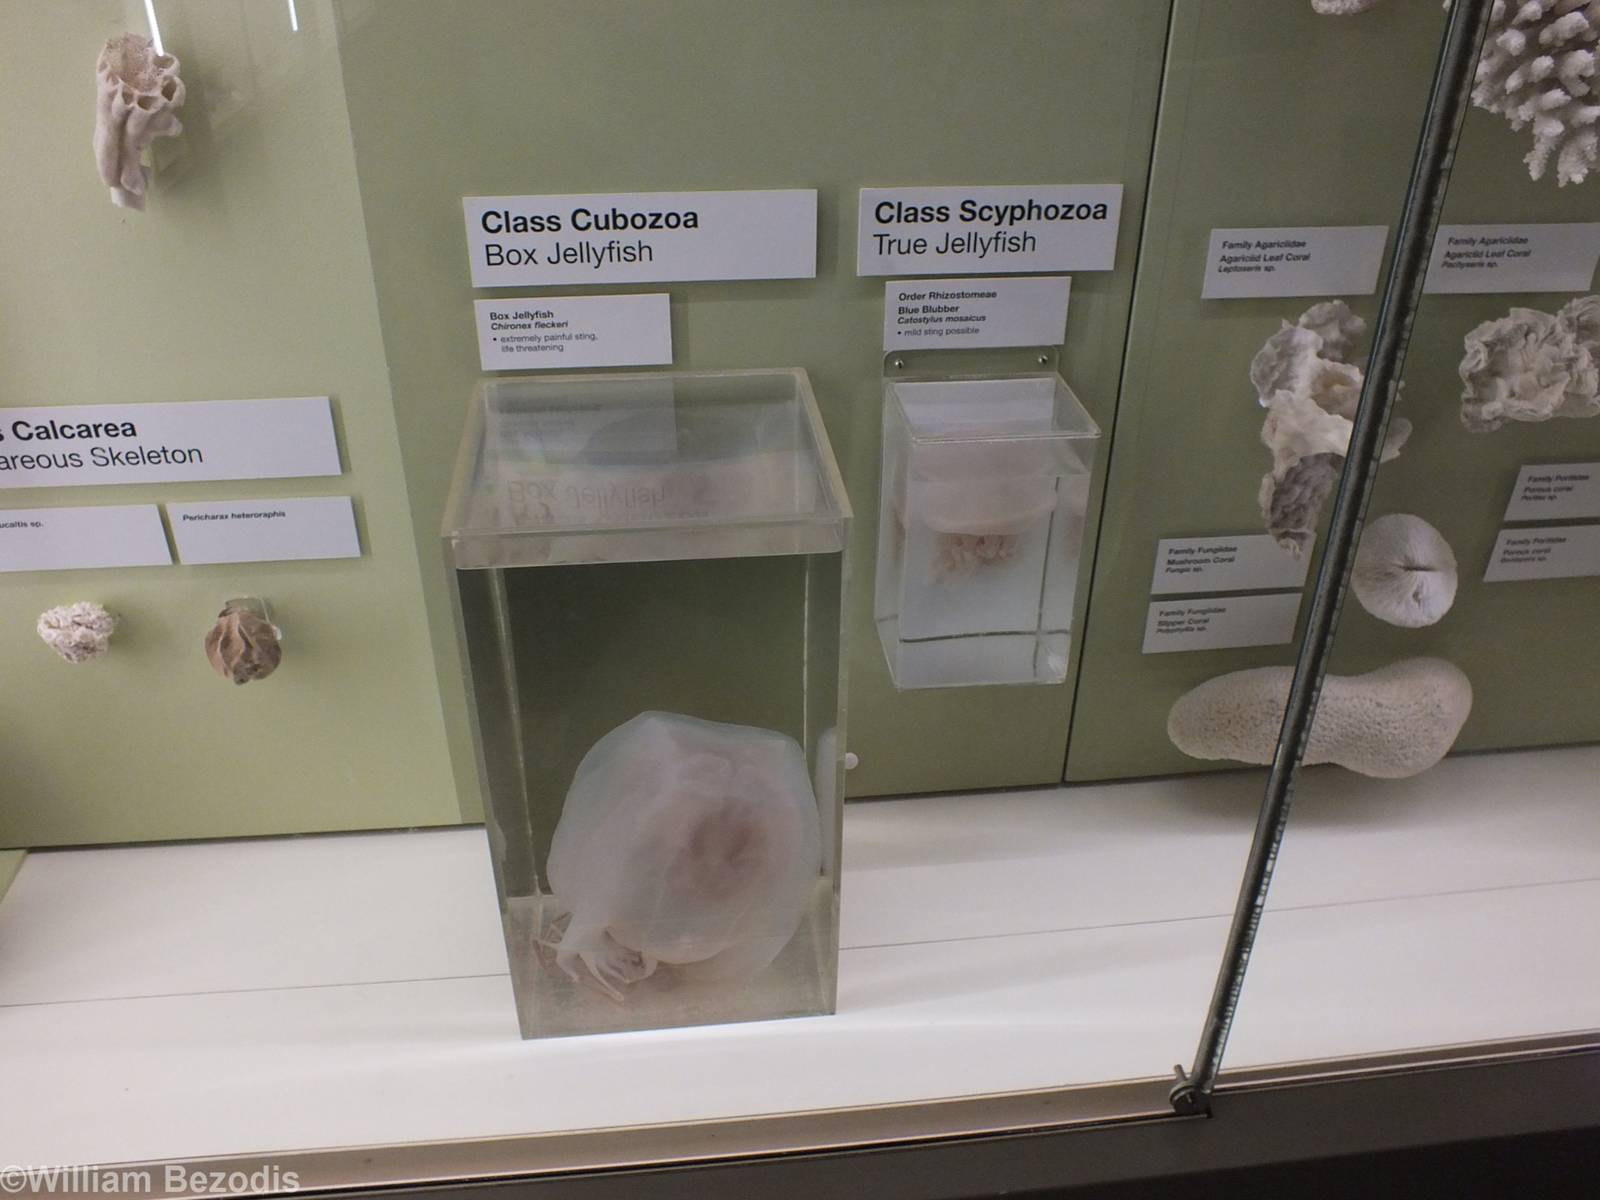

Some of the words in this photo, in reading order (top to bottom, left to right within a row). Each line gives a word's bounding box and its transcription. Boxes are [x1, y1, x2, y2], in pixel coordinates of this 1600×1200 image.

[875, 201, 950, 224] Class
[959, 199, 1108, 226] Scyphozoa
[481, 209, 562, 234] Class
[571, 208, 699, 232] Cubozoa
[873, 233, 928, 256] True
[936, 231, 1036, 259] Jellyfish
[1222, 240, 1252, 250] Family
[1448, 236, 1476, 246] Family
[485, 244, 539, 267] Box
[547, 240, 653, 269] Jellyfish
[1263, 252, 1284, 262] Leaf
[1285, 252, 1311, 261] Coral
[1485, 249, 1506, 259] Leaf
[1507, 248, 1532, 258] Coral
[898, 292, 926, 301] Order
[929, 291, 997, 300] Rhizostomeae
[898, 306, 920, 315] Blue
[922, 304, 960, 314] Blubber
[489, 311, 510, 321] Box
[512, 310, 554, 321] Jellyfish
[897, 315, 943, 325] Catostylus
[945, 314, 986, 323] mosaicus
[491, 322, 532, 331] Chironex
[534, 320, 569, 330] fleckeri
[904, 328, 922, 336] mild
[923, 328, 944, 337] sting
[945, 326, 980, 336] possible
[500, 334, 541, 344] extremely
[544, 332, 573, 343] painful
[574, 332, 598, 342] sting,
[501, 344, 514, 353] life
[516, 343, 564, 353] threatening
[12, 420, 137, 441] Calcarea
[90, 445, 203, 468] Skeleton
[183, 512, 229, 522] Pericharax
[231, 510, 286, 520] heteroraphis
[30, 521, 43, 529] sp.
[1213, 556, 1235, 564] Coral
